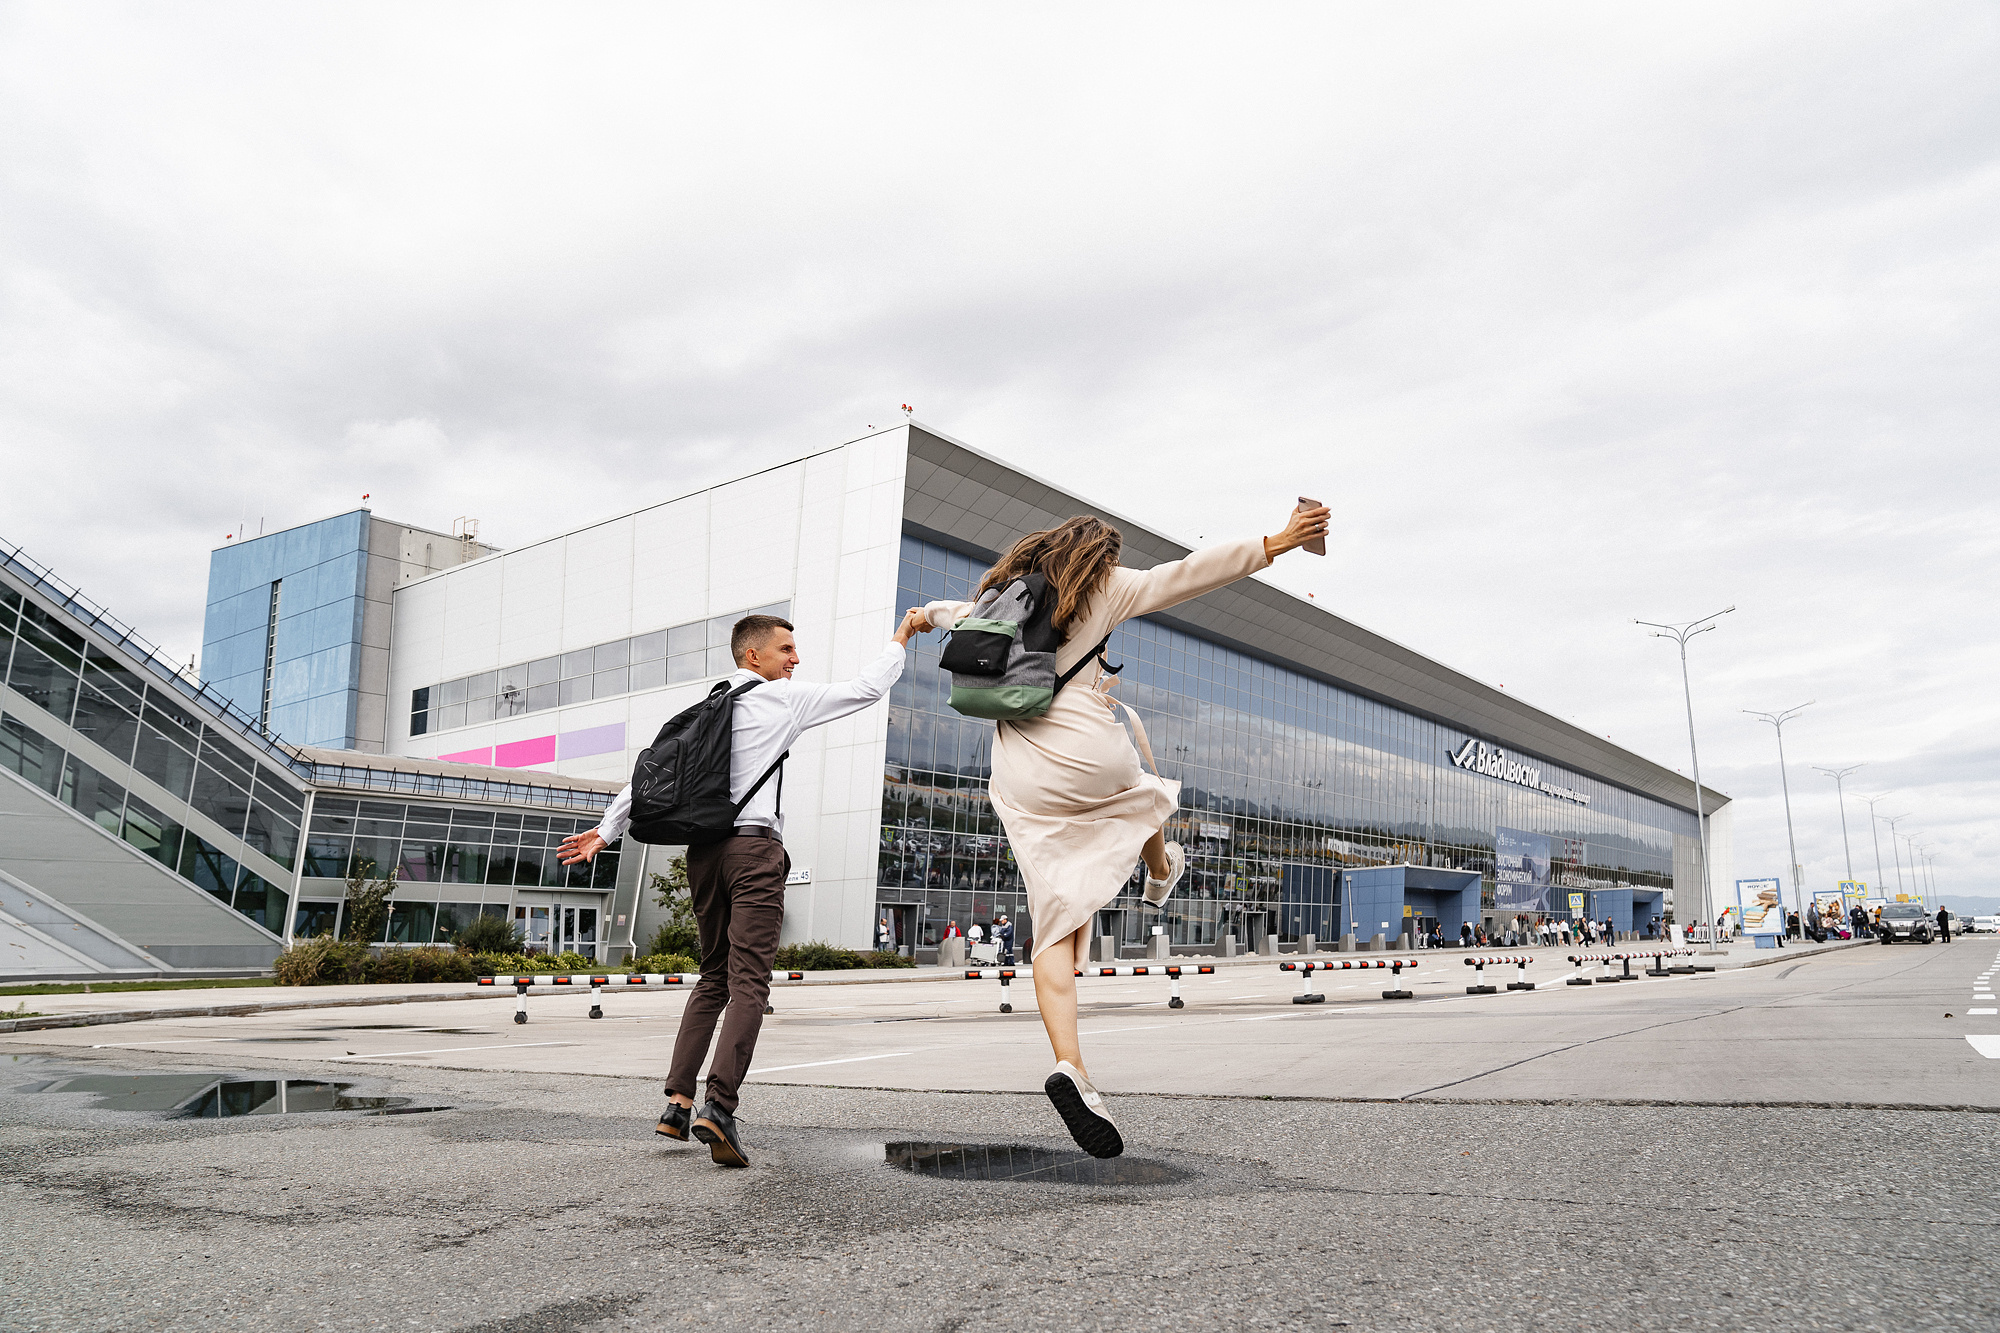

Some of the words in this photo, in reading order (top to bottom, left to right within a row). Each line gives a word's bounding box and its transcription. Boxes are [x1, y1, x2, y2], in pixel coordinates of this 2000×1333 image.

[1477, 741, 1540, 789] Владивосток
[1497, 854, 1523, 869] ВОСТОЧНЫЙ
[800, 871, 809, 880] 45
[1497, 869, 1533, 883] ЭКОНОМИЧЕСКИЙ
[1497, 884, 1513, 897] ФОРУМ
